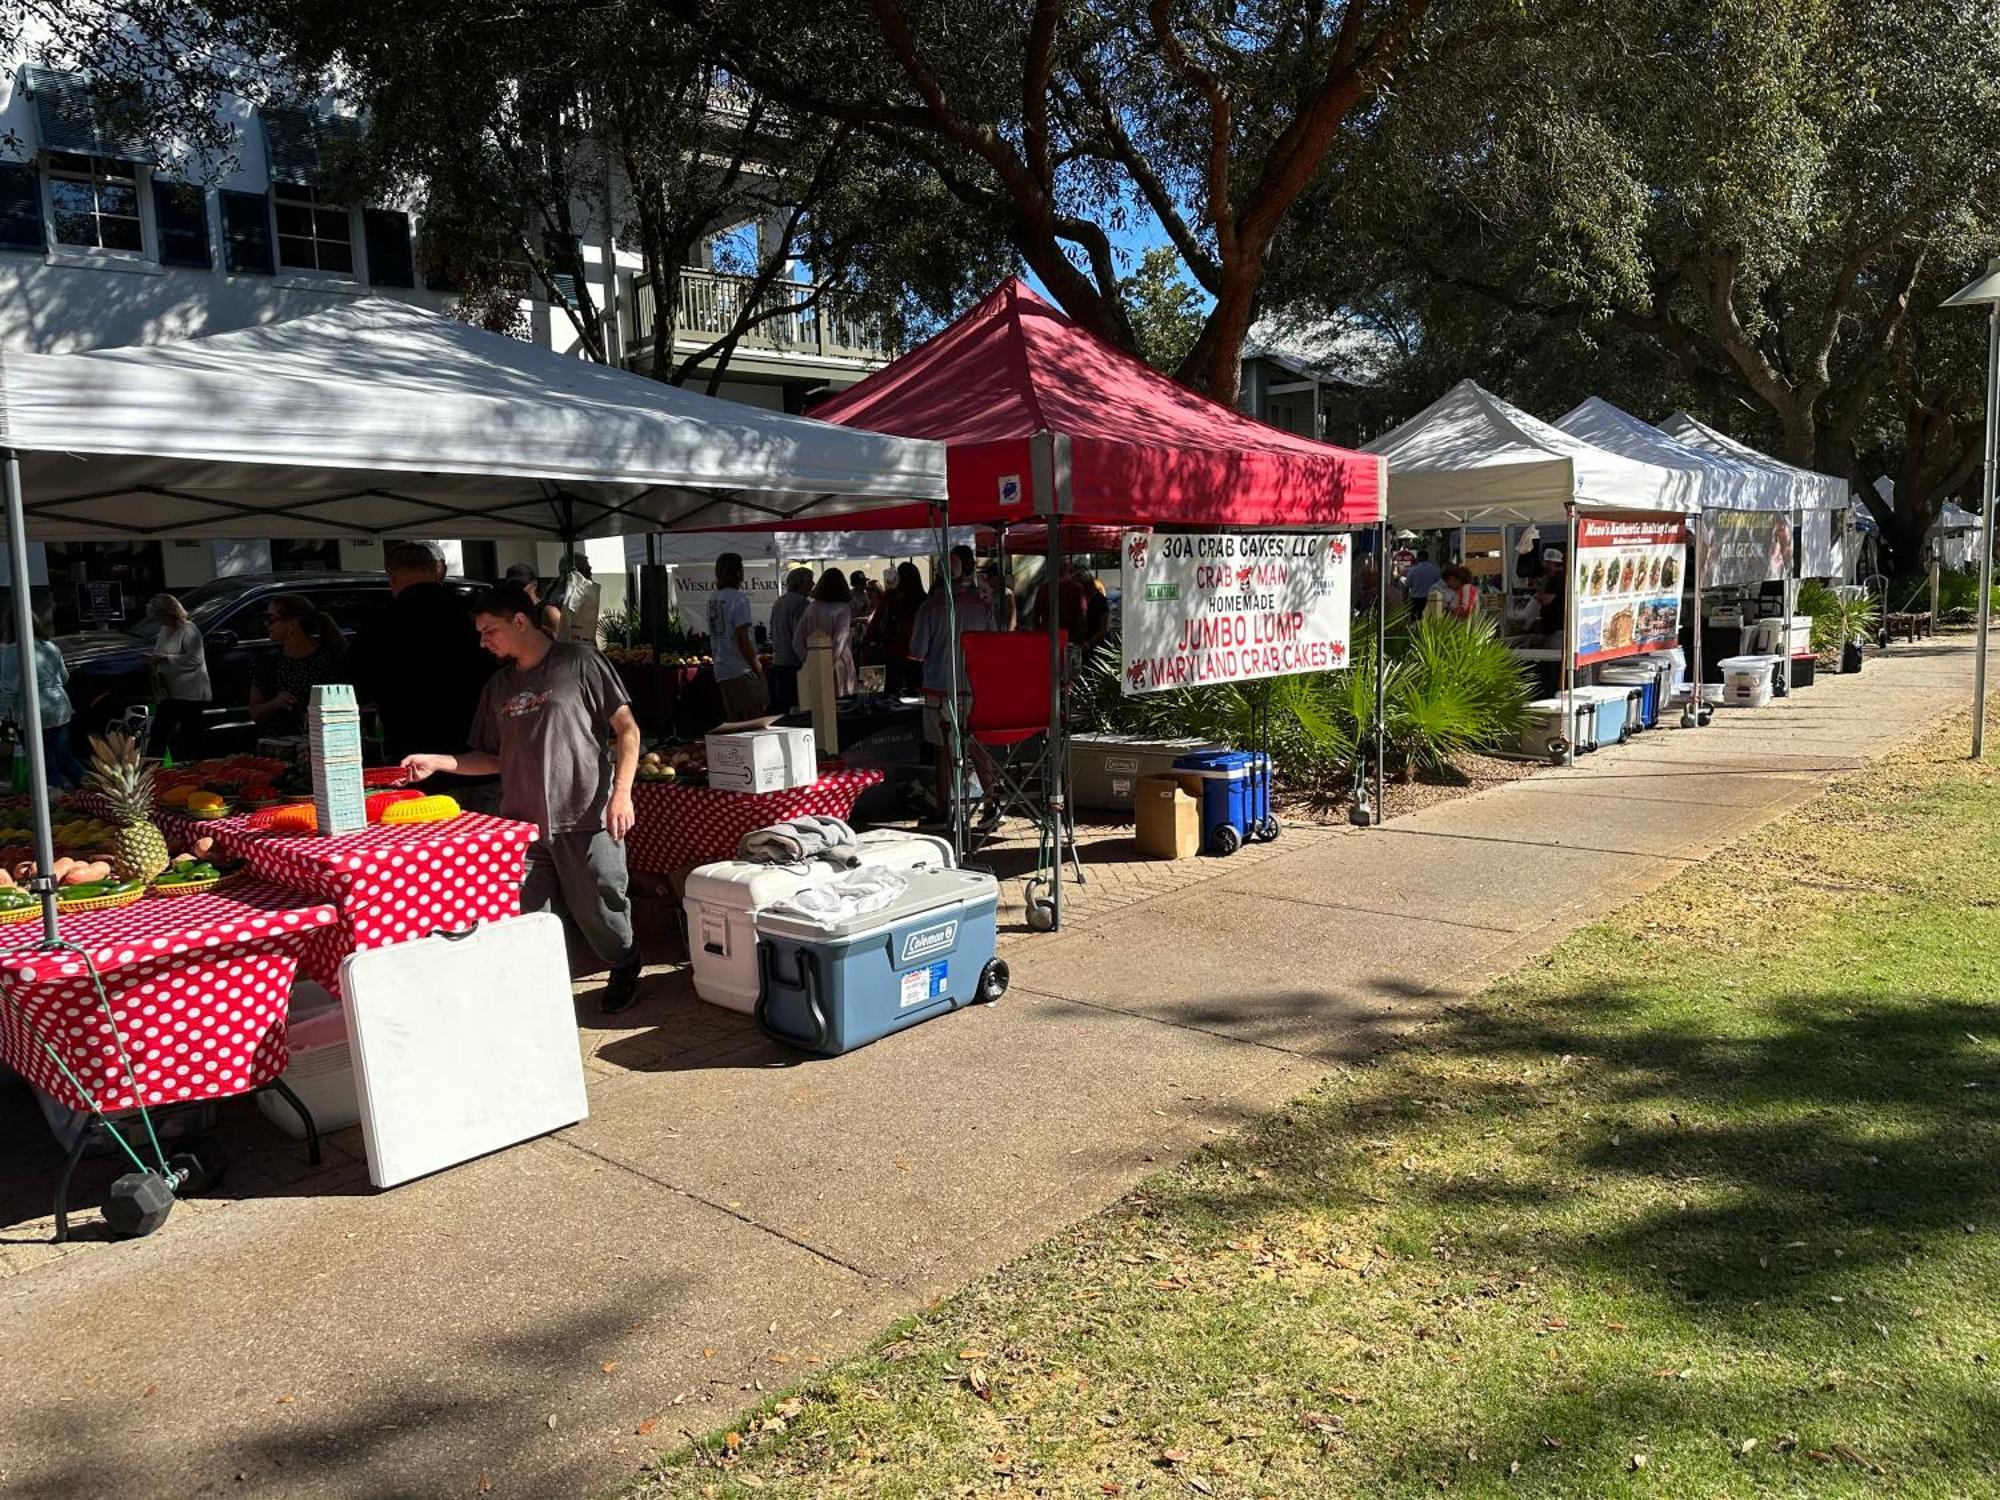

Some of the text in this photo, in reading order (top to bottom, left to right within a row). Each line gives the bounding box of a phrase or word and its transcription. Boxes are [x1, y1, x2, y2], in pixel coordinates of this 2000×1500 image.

[1610, 522, 1640, 535] Authentic
[1641, 522, 1664, 537] Healthy
[1664, 522, 1679, 535] Food
[1162, 538, 1193, 558] 30A
[1198, 538, 1235, 558] CRAB
[1292, 538, 1317, 557] LLC
[1196, 565, 1289, 589] CRAB MAN
[1208, 594, 1276, 613] HOMEMADE
[1178, 611, 1304, 651] JUMBO LUMP
[1150, 642, 1328, 686] MARYLAND CRAB CAKES
[909, 932, 945, 951] Coleman
